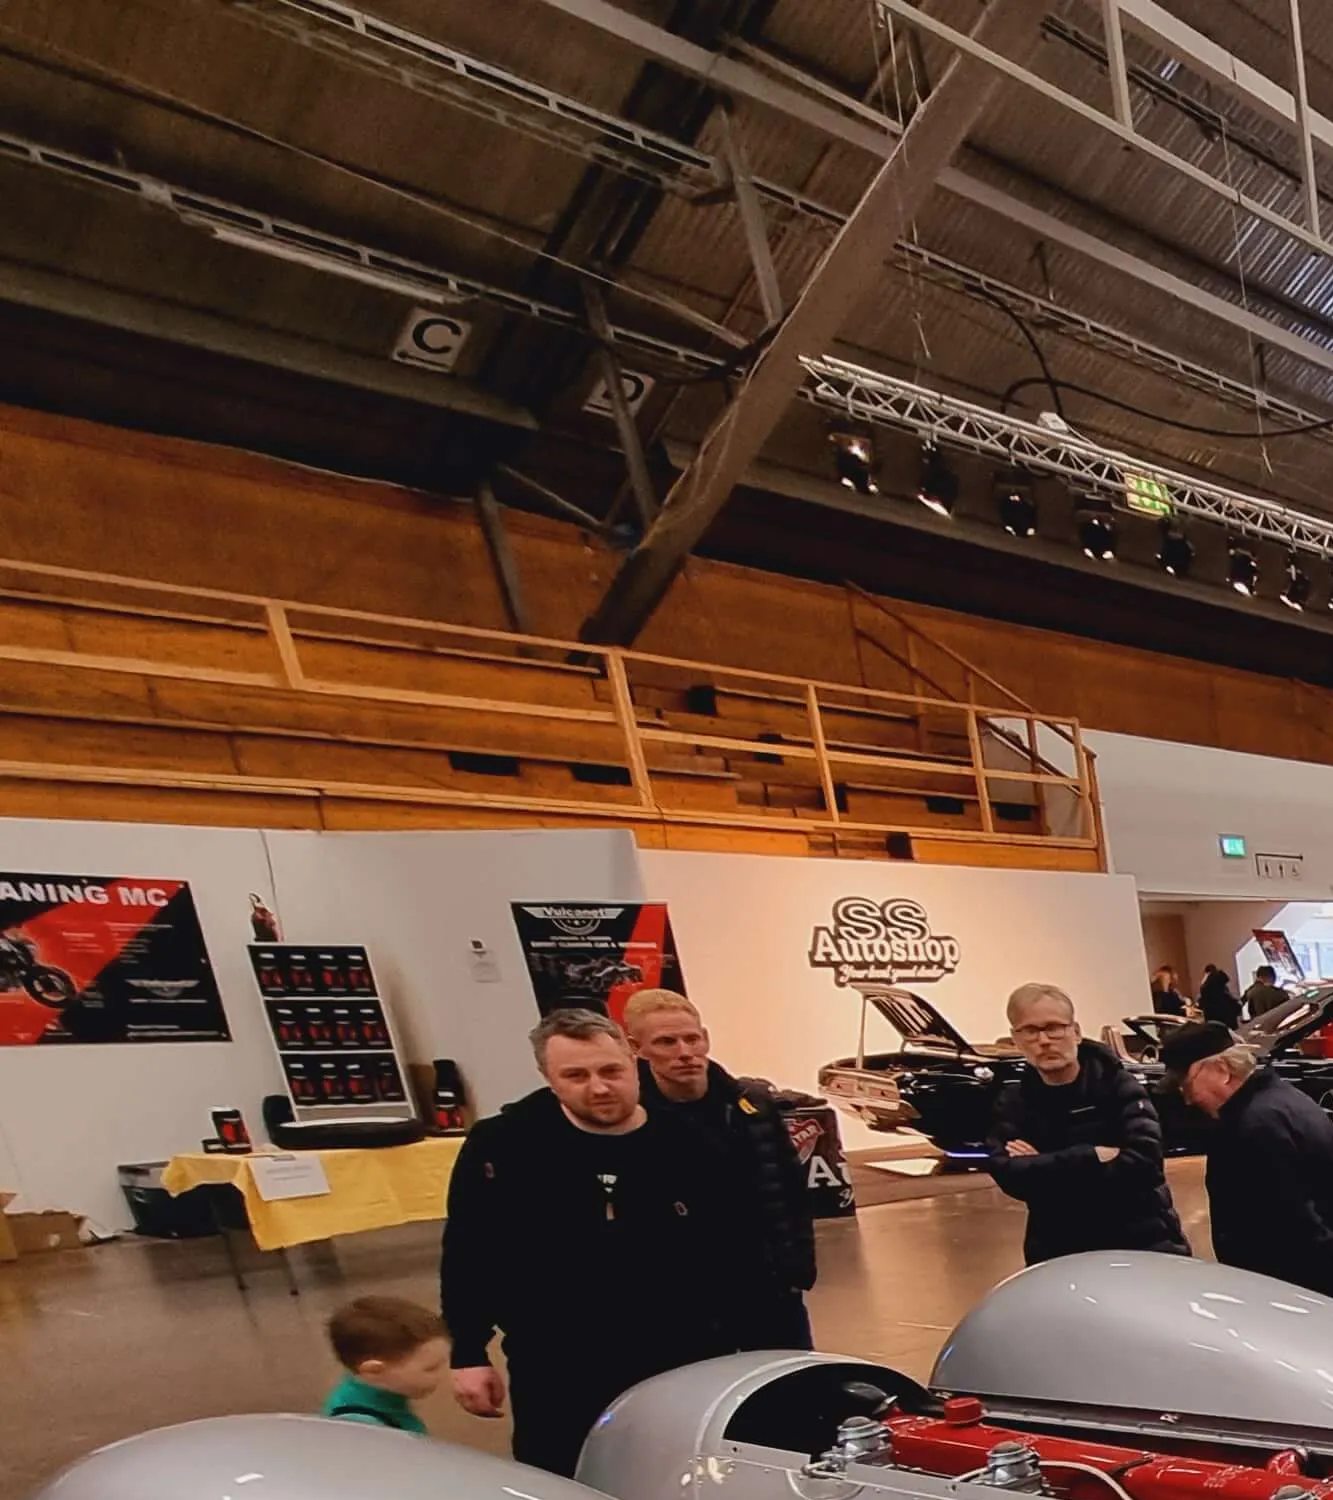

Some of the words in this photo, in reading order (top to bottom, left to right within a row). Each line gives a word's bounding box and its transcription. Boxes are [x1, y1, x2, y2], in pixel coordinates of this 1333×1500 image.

[412, 318, 463, 355] C
[117, 886, 169, 907] MC
[833, 897, 932, 942] SS
[812, 930, 961, 969] Autoshop
